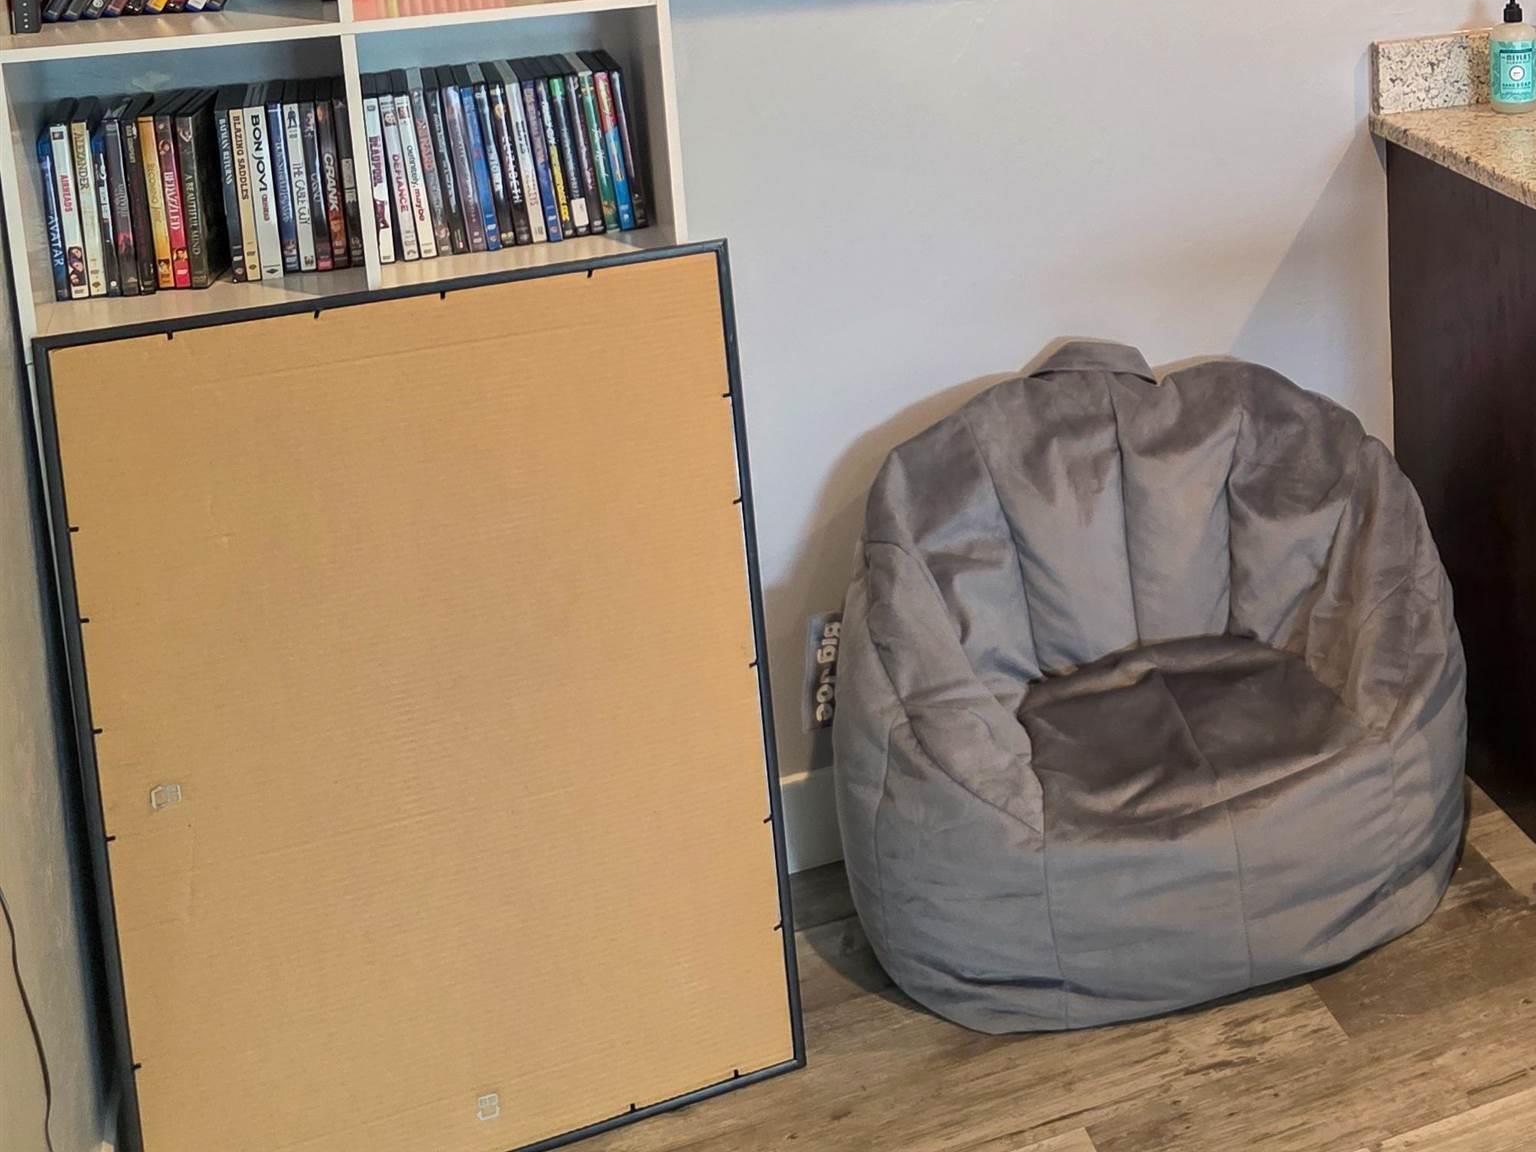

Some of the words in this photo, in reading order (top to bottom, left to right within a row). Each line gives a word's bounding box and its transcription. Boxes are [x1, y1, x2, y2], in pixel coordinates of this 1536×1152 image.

[232, 115, 244, 156] BLAZING
[250, 114, 264, 152] BON
[72, 131, 91, 191] ALEXANDER
[183, 172, 193, 182] A
[237, 157, 249, 201] SADDLES
[252, 152, 268, 192] JOVI
[292, 162, 304, 178] THE
[367, 135, 385, 188] DEADPOOL
[59, 173, 74, 213] AIRHEADS
[162, 170, 182, 231] BEDAZZLED
[294, 179, 308, 205] CABLE
[323, 152, 339, 212] CRANK
[391, 153, 408, 213] DEFIANCE
[184, 181, 200, 228] BEAUTIFUL
[413, 188, 426, 222] maybe
[47, 214, 65, 267] AVATAR
[189, 230, 201, 256] MIND
